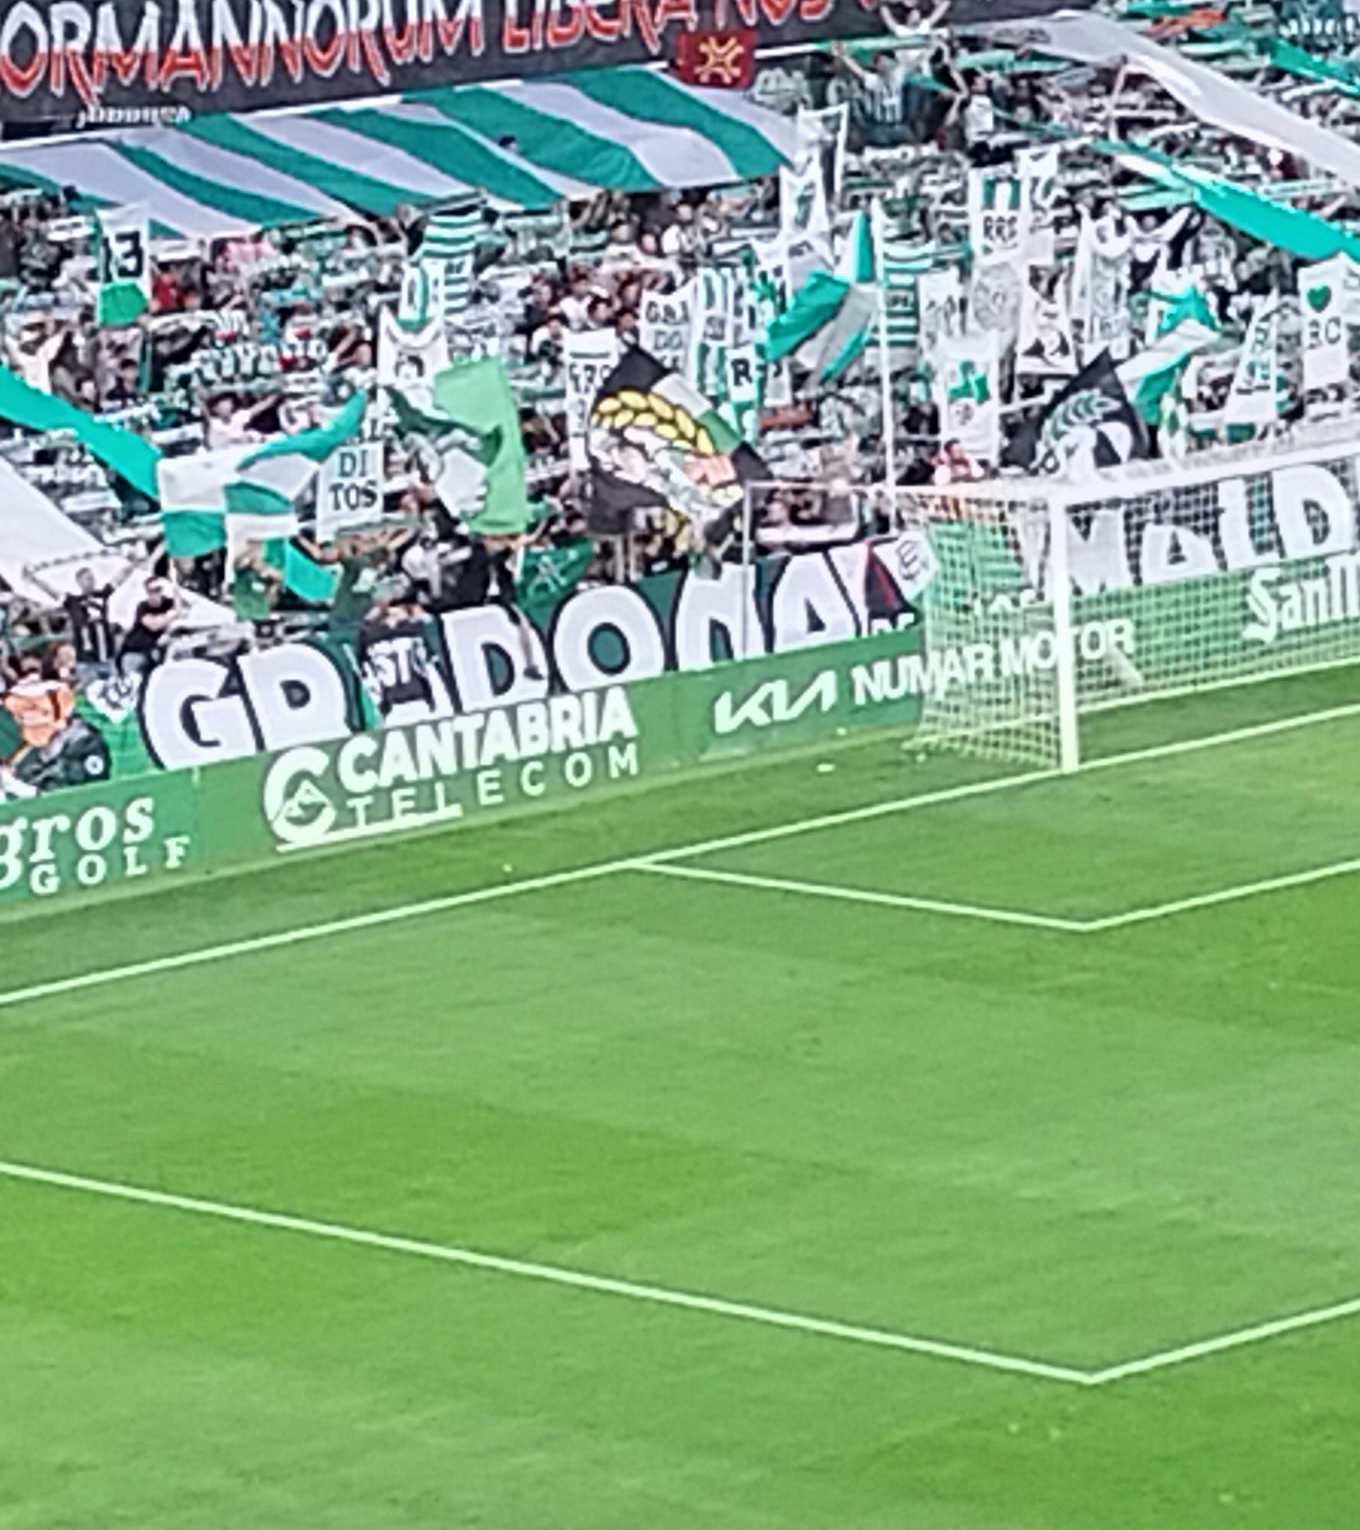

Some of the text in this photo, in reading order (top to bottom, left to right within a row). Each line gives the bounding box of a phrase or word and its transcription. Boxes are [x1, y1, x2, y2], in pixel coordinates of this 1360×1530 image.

[339, 450, 367, 477] DI
[330, 480, 378, 510] TOS
[339, 686, 637, 794] CANTABRIA
[347, 742, 639, 828] TELECOM
[28, 837, 189, 896] GOLF
